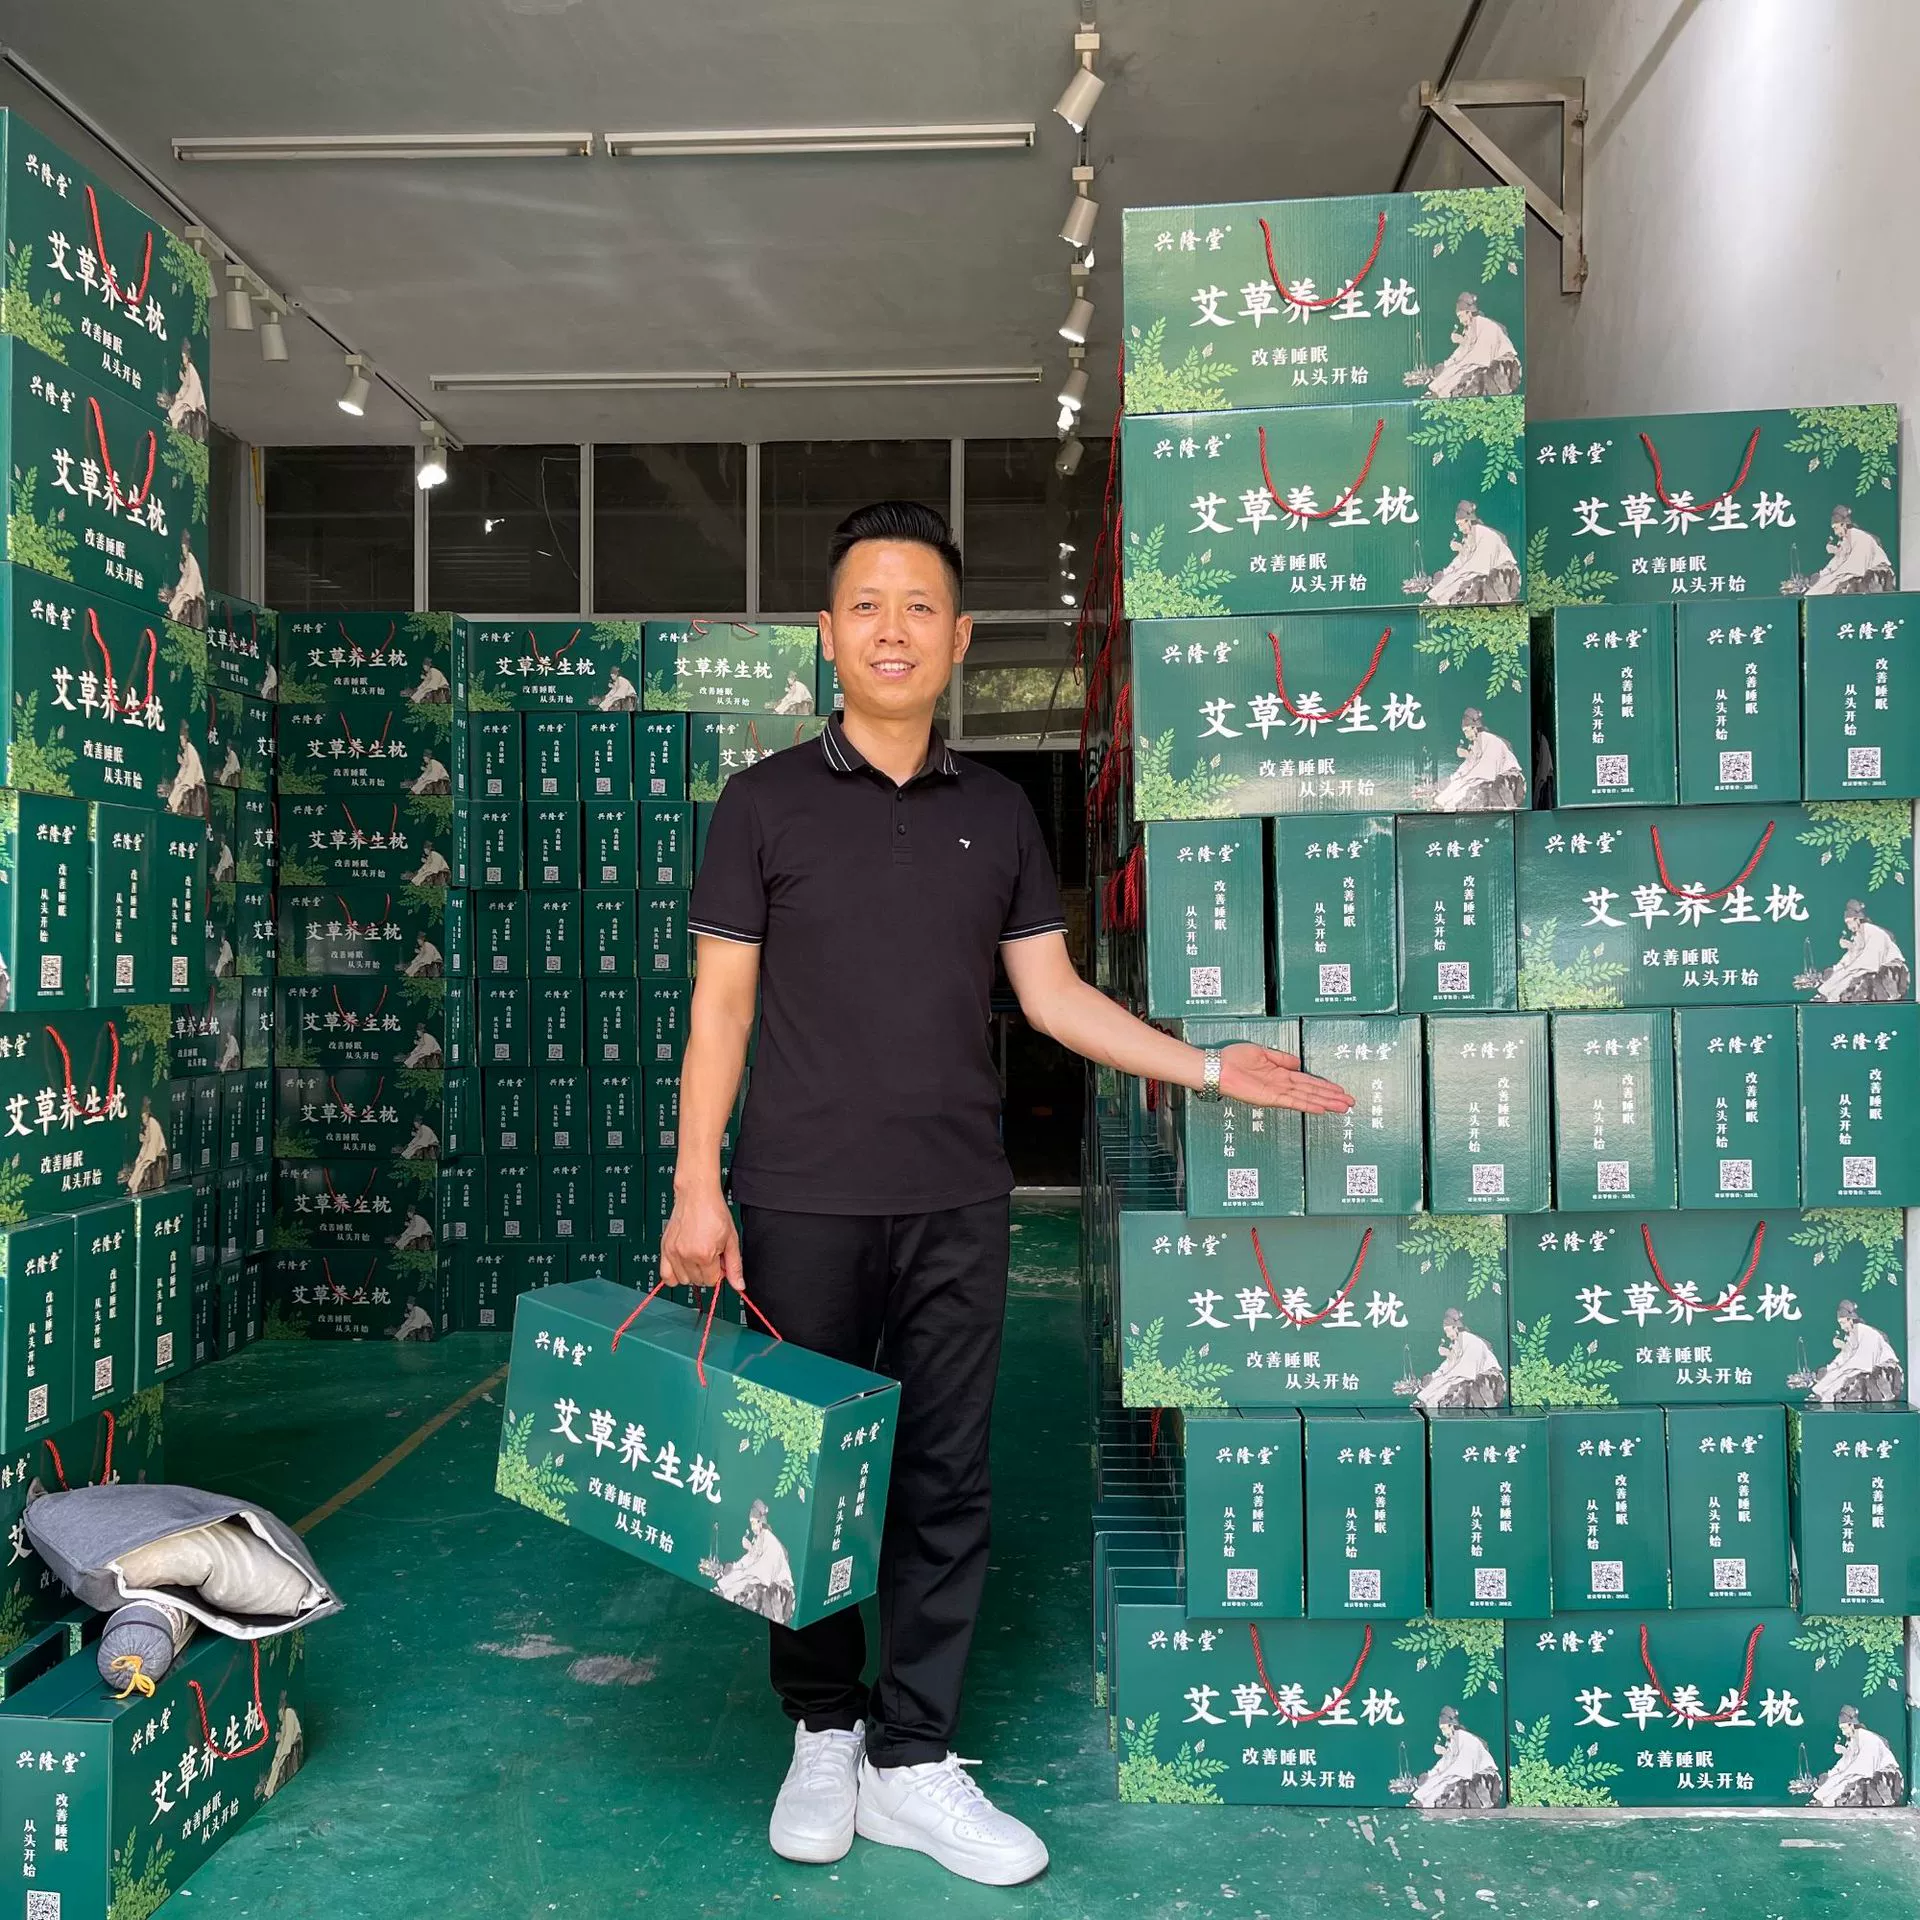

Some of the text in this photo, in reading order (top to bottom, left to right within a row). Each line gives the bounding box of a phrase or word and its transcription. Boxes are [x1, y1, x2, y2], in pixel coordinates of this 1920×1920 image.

[47, 229, 169, 341] 艾草养生枕
[1190, 278, 1420, 328] 艾草养生枕
[82, 317, 122, 356] 改善睡眠
[1252, 345, 1328, 366] 改善睡眠
[102, 350, 141, 389] 从头开始
[1292, 366, 1368, 386] 从头开始
[51, 448, 168, 536] 艾草养生枕
[1189, 485, 1419, 535] 艾草养生枕
[1572, 491, 1796, 538] 艾草养生枕
[85, 528, 125, 559] 改善睡眠
[1250, 553, 1327, 572] 改善睡眠
[1632, 556, 1706, 574] 改善睡眠
[105, 560, 143, 589] 从头开始
[1290, 573, 1367, 593] 从头开始
[1671, 575, 1746, 593] 从头开始
[496, 656, 595, 676] 艾草养生枕
[673, 657, 772, 679] 艾草养生枕
[1875, 658, 1888, 709] 改善睡眠
[51, 666, 165, 731] 艾草养生枕
[540, 695, 573, 703] 从头开始
[699, 687, 733, 695] 改善睡眠
[716, 697, 750, 706] 从头开始
[1622, 667, 1634, 717] 改善睡眠
[1845, 684, 1857, 735] 从头开始
[1198, 691, 1426, 740] 艾草养生枕
[1592, 693, 1604, 743] 从头开始
[84, 740, 123, 763] 改善睡眠
[1260, 758, 1335, 776] 改善睡眠
[104, 767, 142, 789] 从头开始
[1299, 779, 1375, 798] 从头开始
[58, 864, 67, 916] 改善睡眠
[1214, 880, 1227, 930] 改善睡眠
[1464, 876, 1475, 925] 改善睡眠
[1582, 882, 1809, 929] 艾草养生枕
[40, 889, 49, 942] 从头开始
[115, 893, 123, 943] 从头开始
[1186, 906, 1198, 955] 从头开始
[1434, 901, 1446, 951] 从头开始
[1644, 948, 1719, 966] 改善睡眠
[1683, 969, 1759, 987] 从头开始
[169, 1016, 219, 1038] 草养生枕
[5, 1085, 127, 1137] 艾草养生枕
[1372, 1079, 1384, 1129] 改善睡眠
[1622, 1074, 1635, 1124] 改善睡眠
[1870, 1069, 1882, 1119] 改善睡眠
[1224, 1107, 1235, 1157] 从头开始
[1593, 1100, 1605, 1149] 从头开始
[1839, 1094, 1852, 1145] 从头开始
[41, 1151, 83, 1175] 改善睡眠
[62, 1167, 102, 1192] 从头开始
[109, 1268, 117, 1318] 改善睡眠
[1187, 1286, 1408, 1331] 艾草养生枕
[1575, 1281, 1802, 1327] 艾草养生枕
[45, 1291, 53, 1344] 改善睡眠
[27, 1323, 36, 1377] 从头开始
[1247, 1351, 1320, 1368] 改善睡眠
[1636, 1346, 1712, 1363] 改善睡眠
[1286, 1373, 1359, 1390] 从头开始
[1677, 1367, 1752, 1384] 从头开始
[2, 1459, 27, 1489] 隆堂
[550, 1398, 721, 1504] 艾草养生枕
[589, 1477, 646, 1517] 改善睡眠
[855, 1462, 869, 1516] 改善睡眠
[1253, 1482, 1264, 1532] 改善睡眠
[1500, 1481, 1512, 1532] 改善睡眠
[1872, 1477, 1885, 1528] 改善睡眠
[615, 1512, 673, 1553] 从头开始
[832, 1496, 845, 1551] 从头开始
[1224, 1507, 1235, 1557] 从头开始
[1471, 1506, 1483, 1556] 从头开始
[1842, 1502, 1854, 1553] 从头开始
[1183, 1682, 1404, 1728] 艾草养生枕
[1574, 1682, 1804, 1731] 艾草养生枕
[150, 1701, 264, 1825] 艾草养生枕
[1243, 1748, 1316, 1765] 改善睡眠
[1282, 1771, 1355, 1788] 从头开始
[1637, 1750, 1714, 1767] 改善睡眠
[1677, 1772, 1754, 1789] 从头开始
[55, 1793, 68, 1852] 改善睡眠
[183, 1790, 221, 1843] 改善睡眠
[202, 1798, 238, 1843] 从头开始
[23, 1820, 36, 1877] 从头开始
